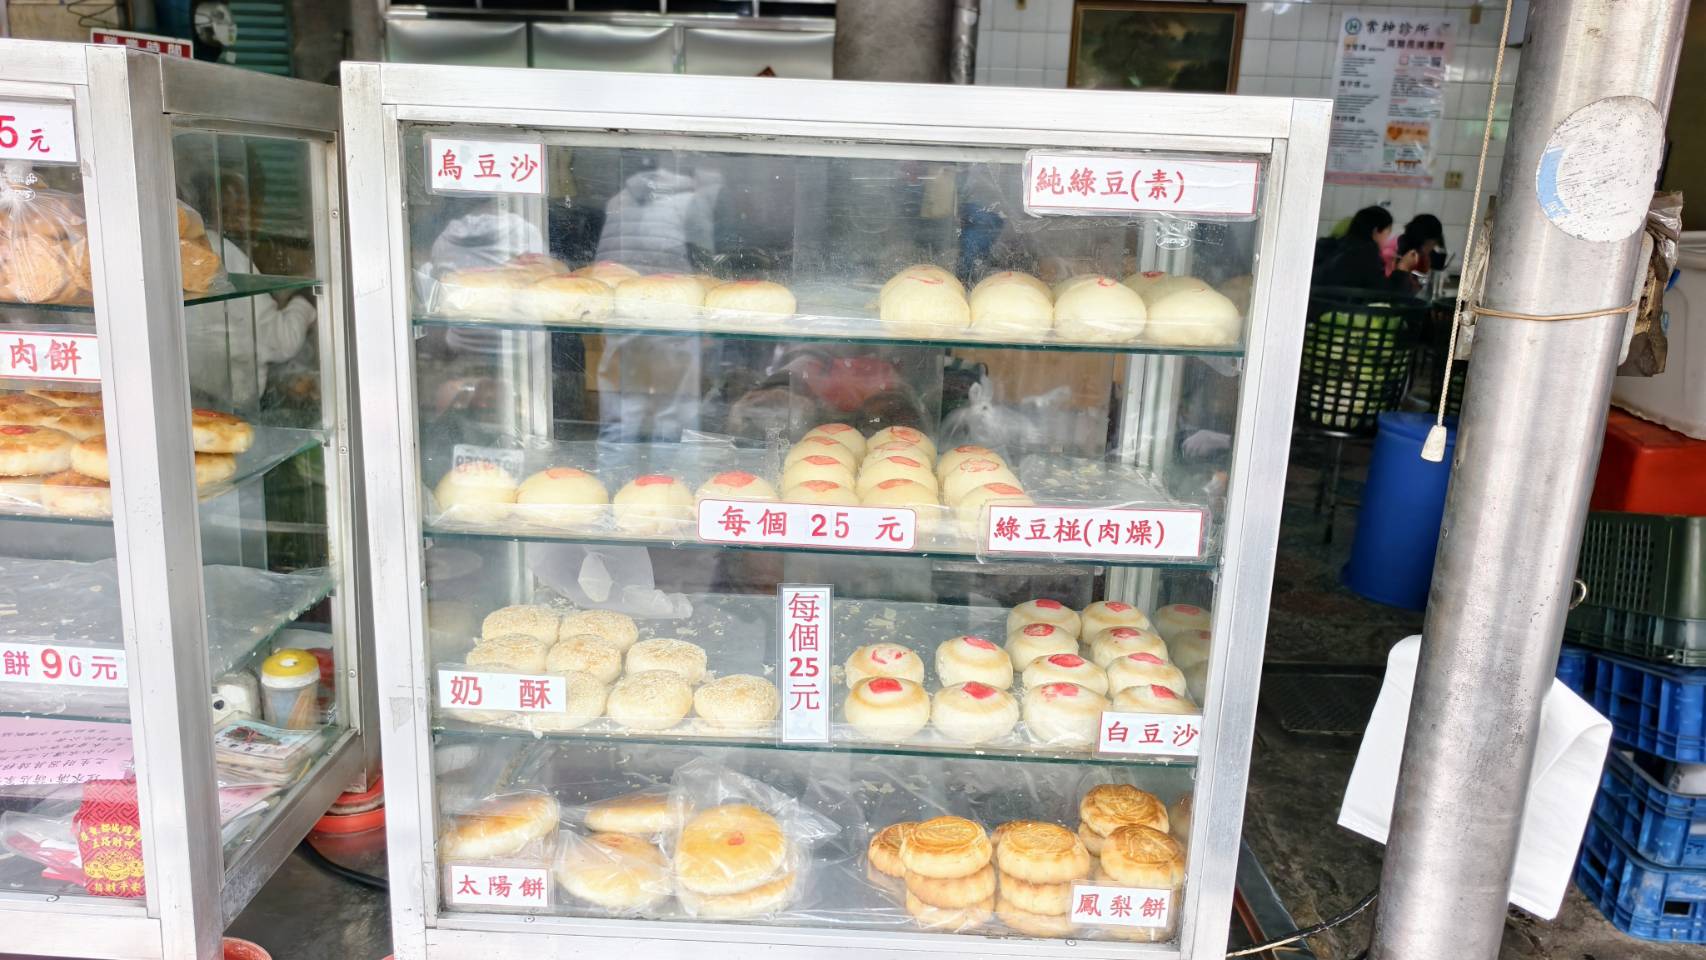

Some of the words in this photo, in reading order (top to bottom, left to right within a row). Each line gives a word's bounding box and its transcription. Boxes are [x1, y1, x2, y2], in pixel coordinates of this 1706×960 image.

[437, 149, 538, 182] 烏豆沙
[1035, 166, 1184, 203] 純綠豆(素)
[9, 338, 82, 375] 肉餅
[993, 515, 1165, 549] 綠豆椪(肉燥)
[1107, 721, 1199, 747] 白豆沙
[456, 873, 547, 900] 太陽餅
[1075, 893, 1167, 920] 鳳梨餅
